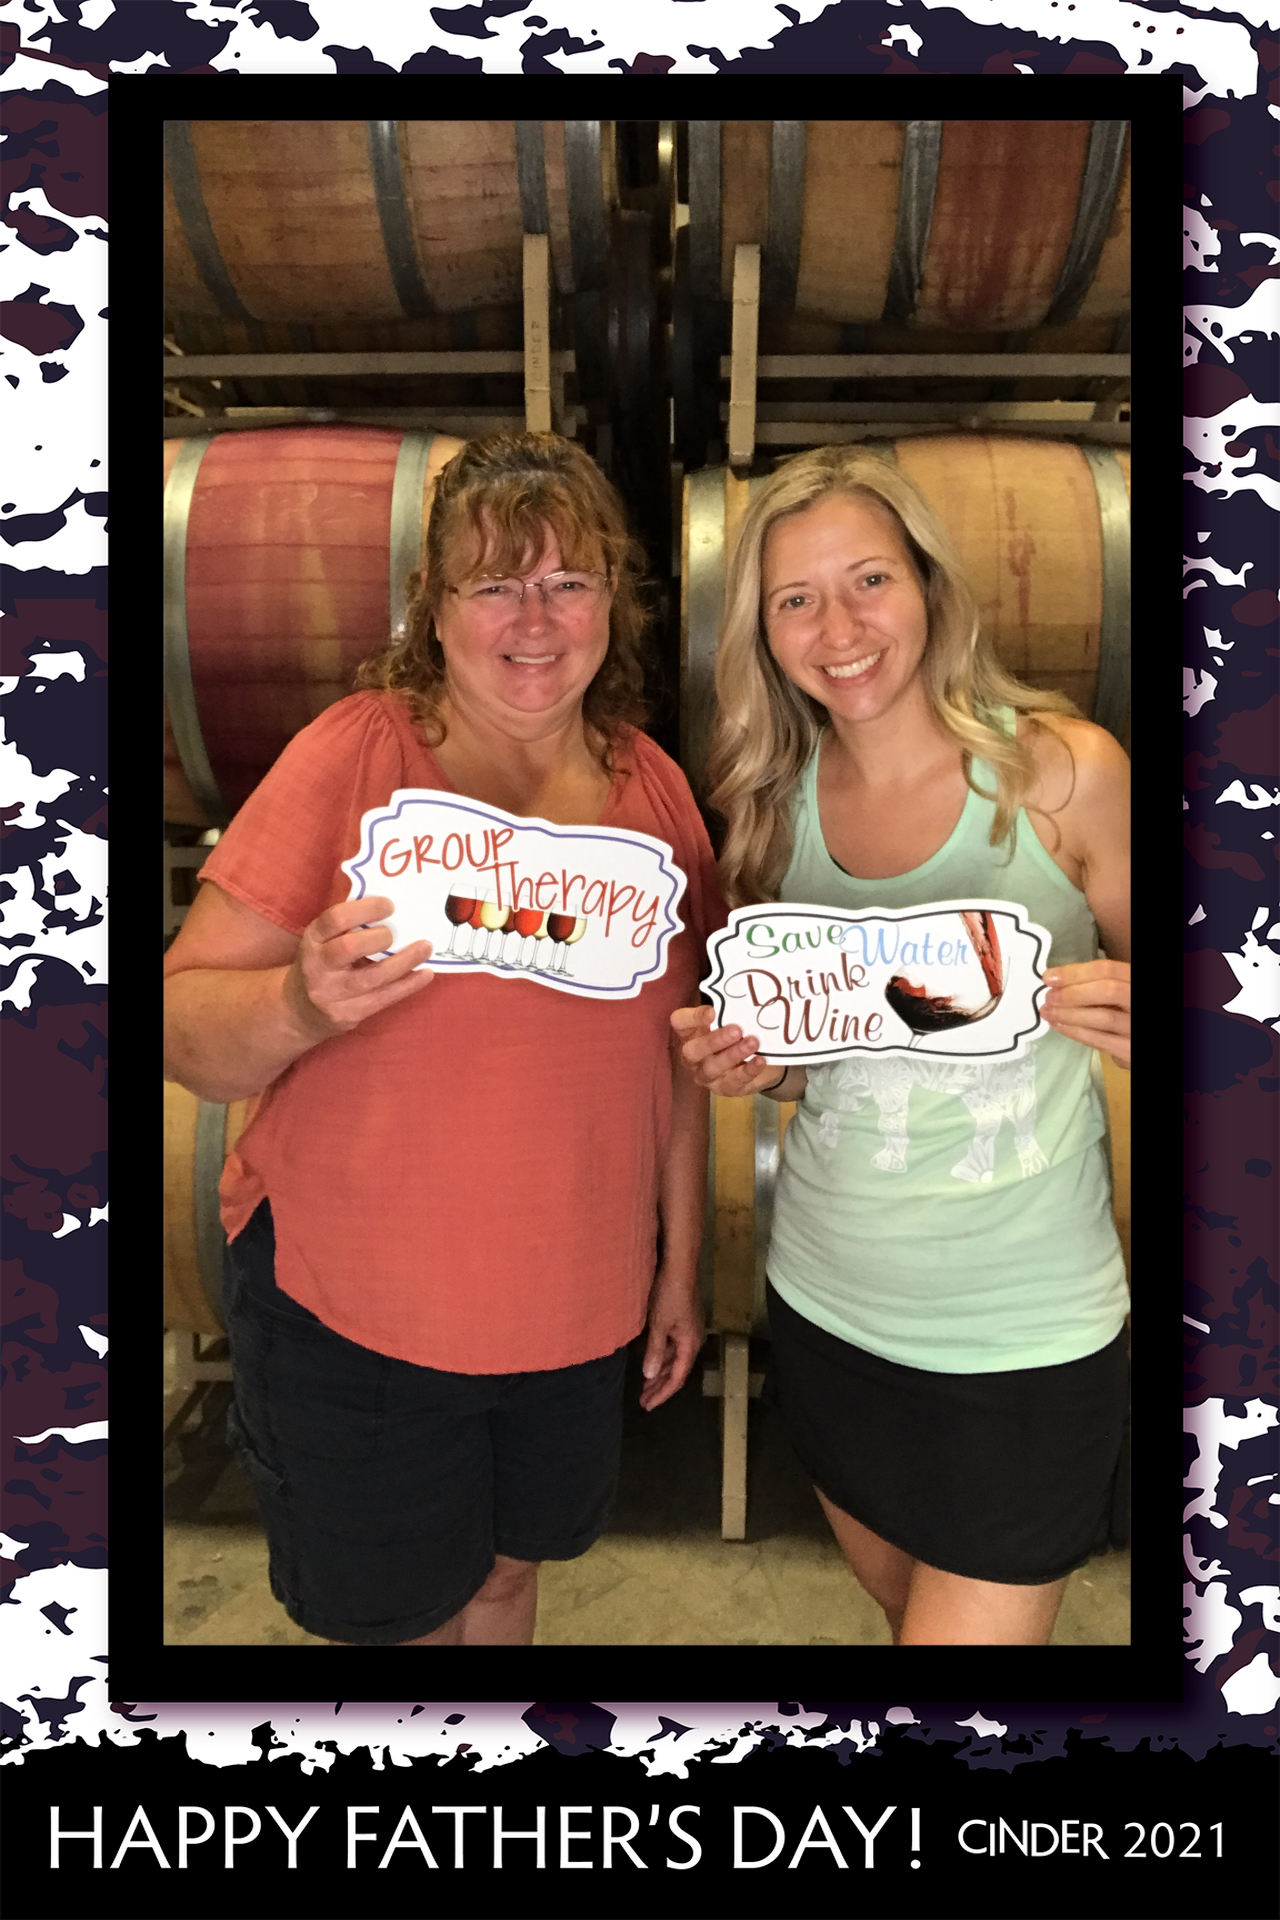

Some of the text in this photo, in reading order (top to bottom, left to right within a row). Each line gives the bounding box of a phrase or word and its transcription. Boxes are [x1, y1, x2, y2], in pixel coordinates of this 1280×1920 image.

[379, 828, 514, 877] GROUP
[477, 860, 660, 948] Therapy
[746, 923, 968, 966] Save Water
[723, 952, 870, 1006] Drink
[756, 995, 883, 1045] Wine
